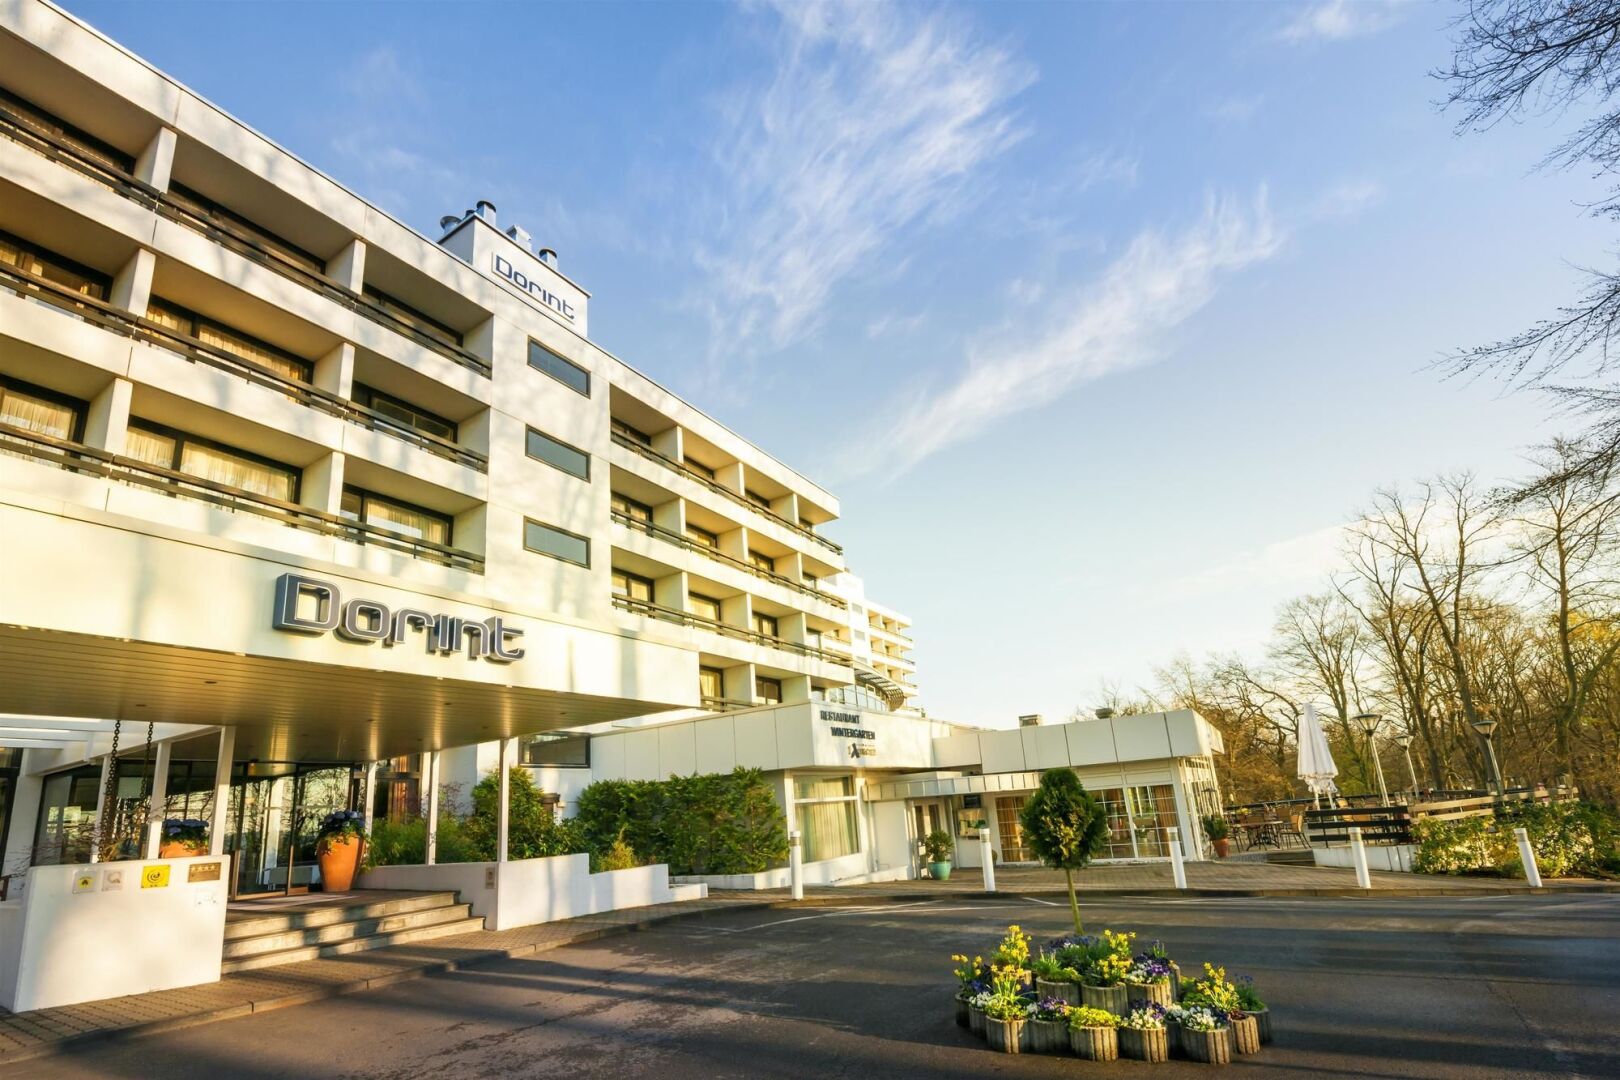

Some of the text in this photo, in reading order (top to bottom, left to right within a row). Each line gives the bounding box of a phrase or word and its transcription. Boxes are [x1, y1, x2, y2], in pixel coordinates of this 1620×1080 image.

[495, 255, 575, 320] Dorint
[273, 572, 526, 663] Dorint
[820, 710, 860, 724] RESTAURANT
[830, 726, 875, 740] WINTERGARTEN
